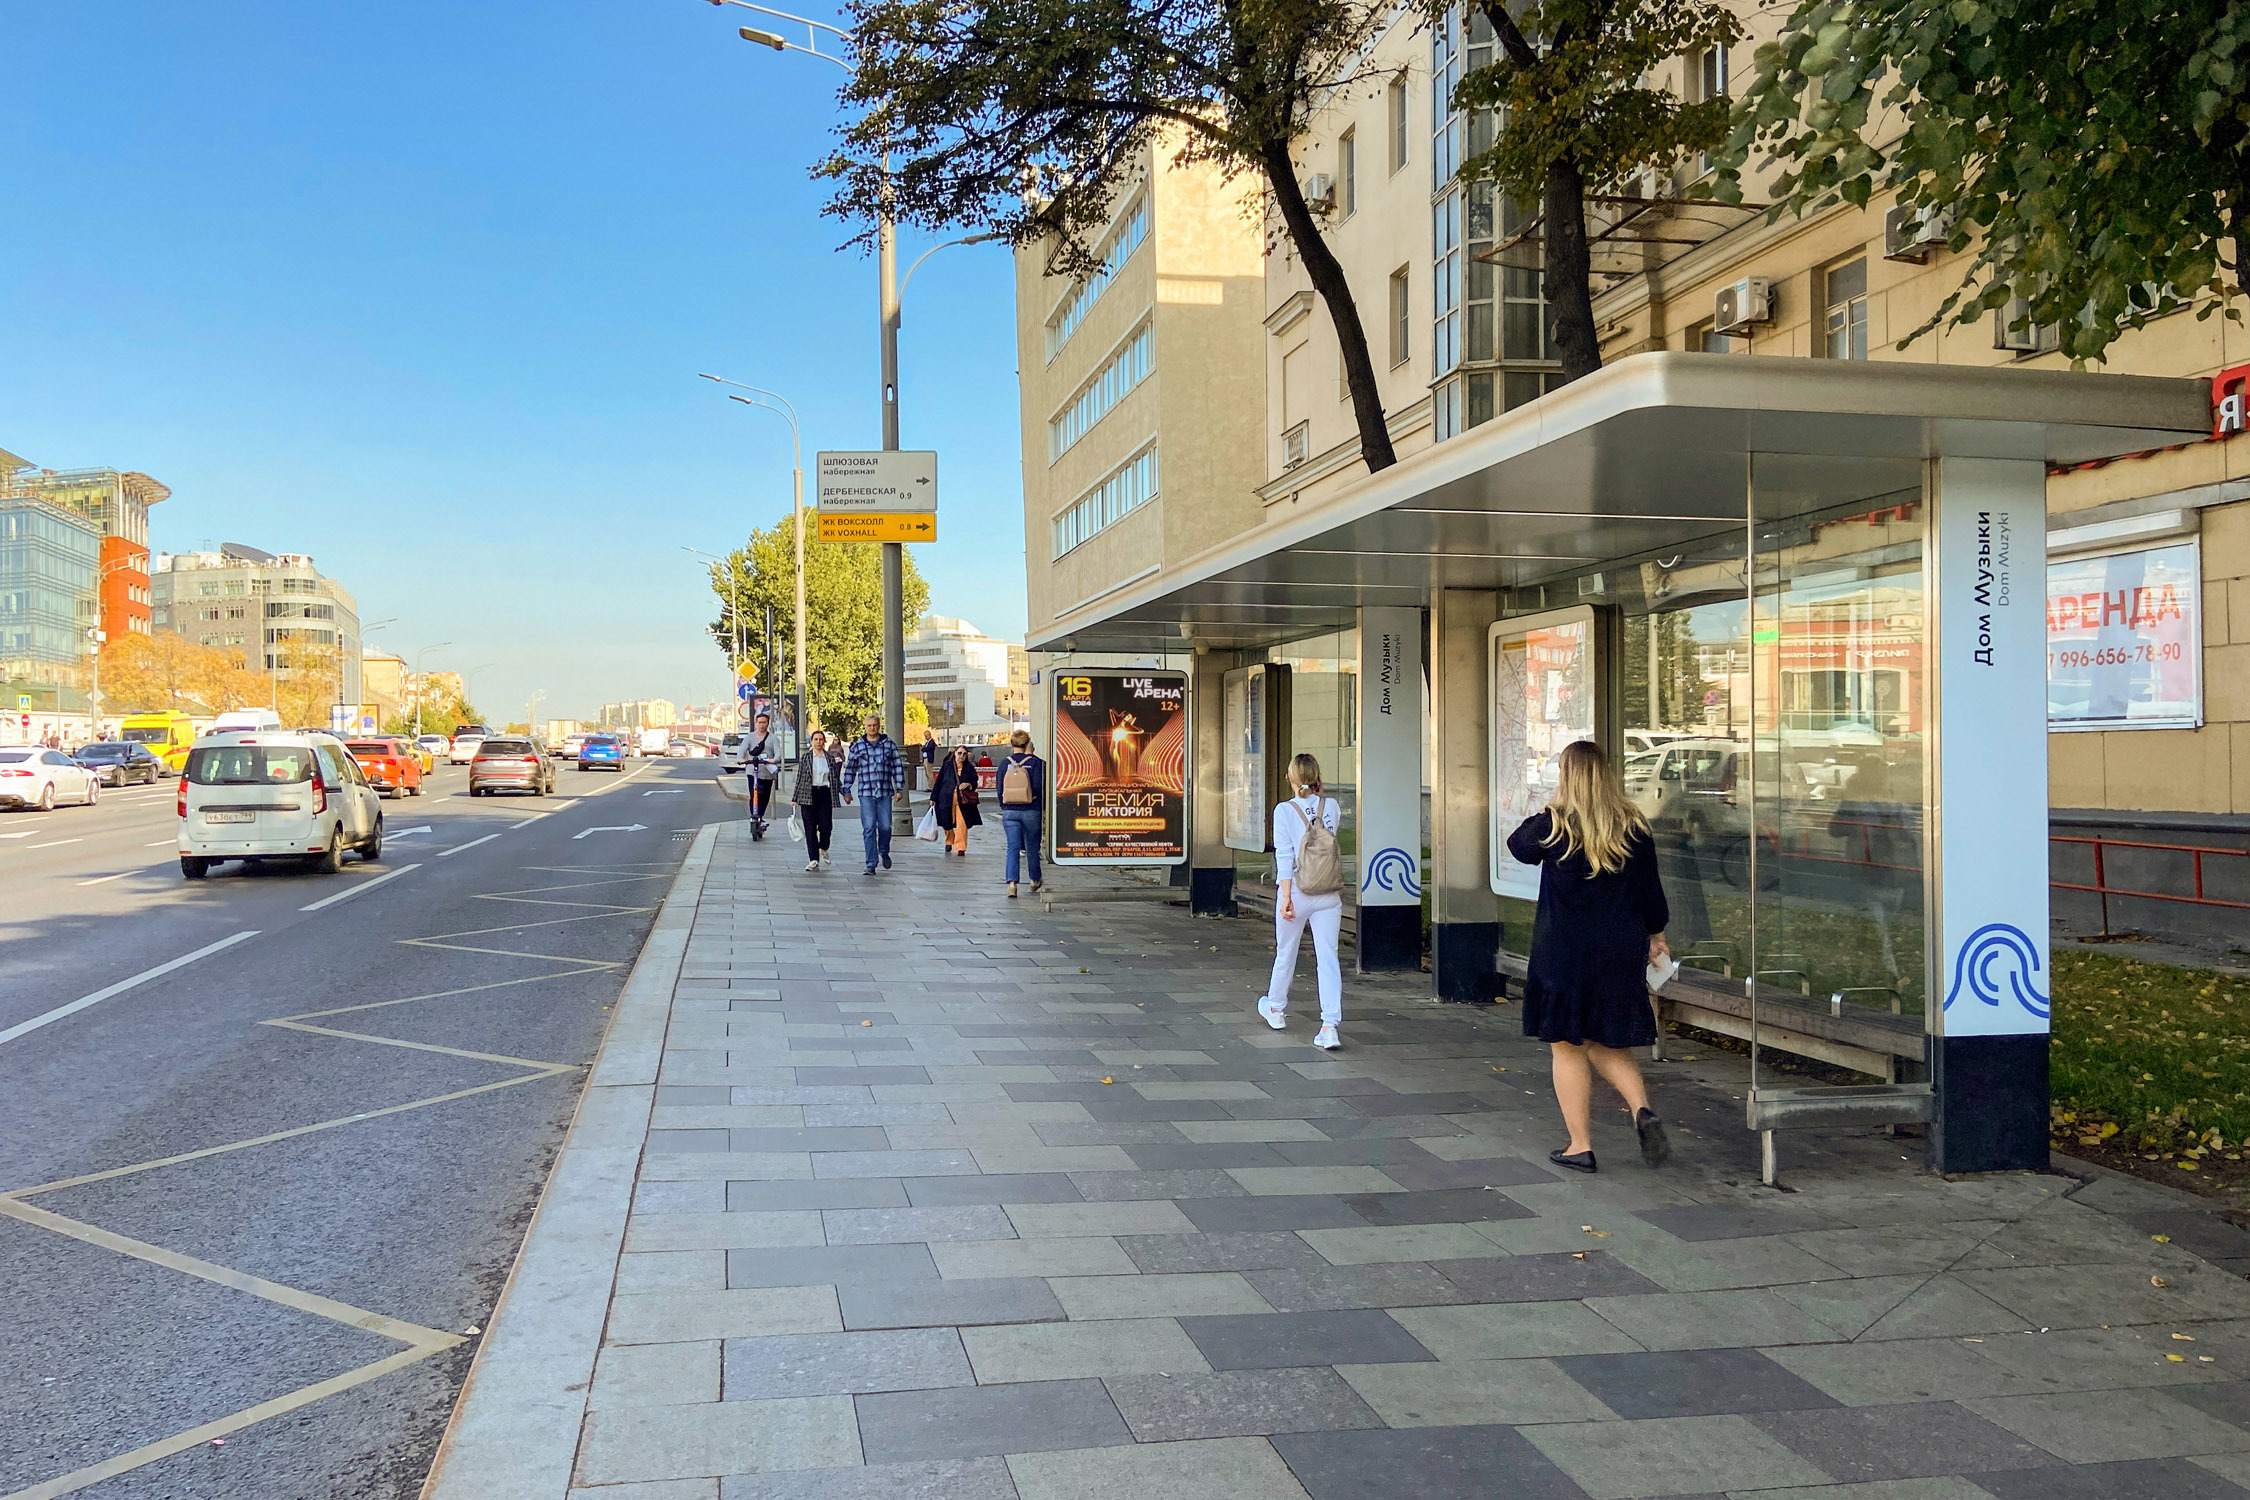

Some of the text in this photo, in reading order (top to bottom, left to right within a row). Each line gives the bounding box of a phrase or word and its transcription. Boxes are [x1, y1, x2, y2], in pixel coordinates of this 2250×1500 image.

[823, 458, 878, 466] ШЛЮЗОВАЯ
[823, 468, 875, 477] набережная
[823, 487, 896, 496] ДЕРБЕНЕВСКАЯ
[823, 498, 876, 506] набережная
[822, 518, 884, 526] ЖК ВОКСХОЛЛ
[822, 529, 877, 537] ЖК VOXHALL
[1997, 512, 2011, 607] Dom Muzyki
[1974, 511, 1994, 667] Дом Музыки
[2060, 642, 2181, 668] 996-656-78-90
[1380, 634, 1392, 715] Дом Музыки
[1059, 676, 1092, 696] 16
[1122, 678, 1153, 688] LIVE
[1161, 701, 1180, 711] 12+
[1076, 793, 1164, 807] ПРЕМИЯ
[1088, 807, 1153, 817] ВИКТОРИЯ
